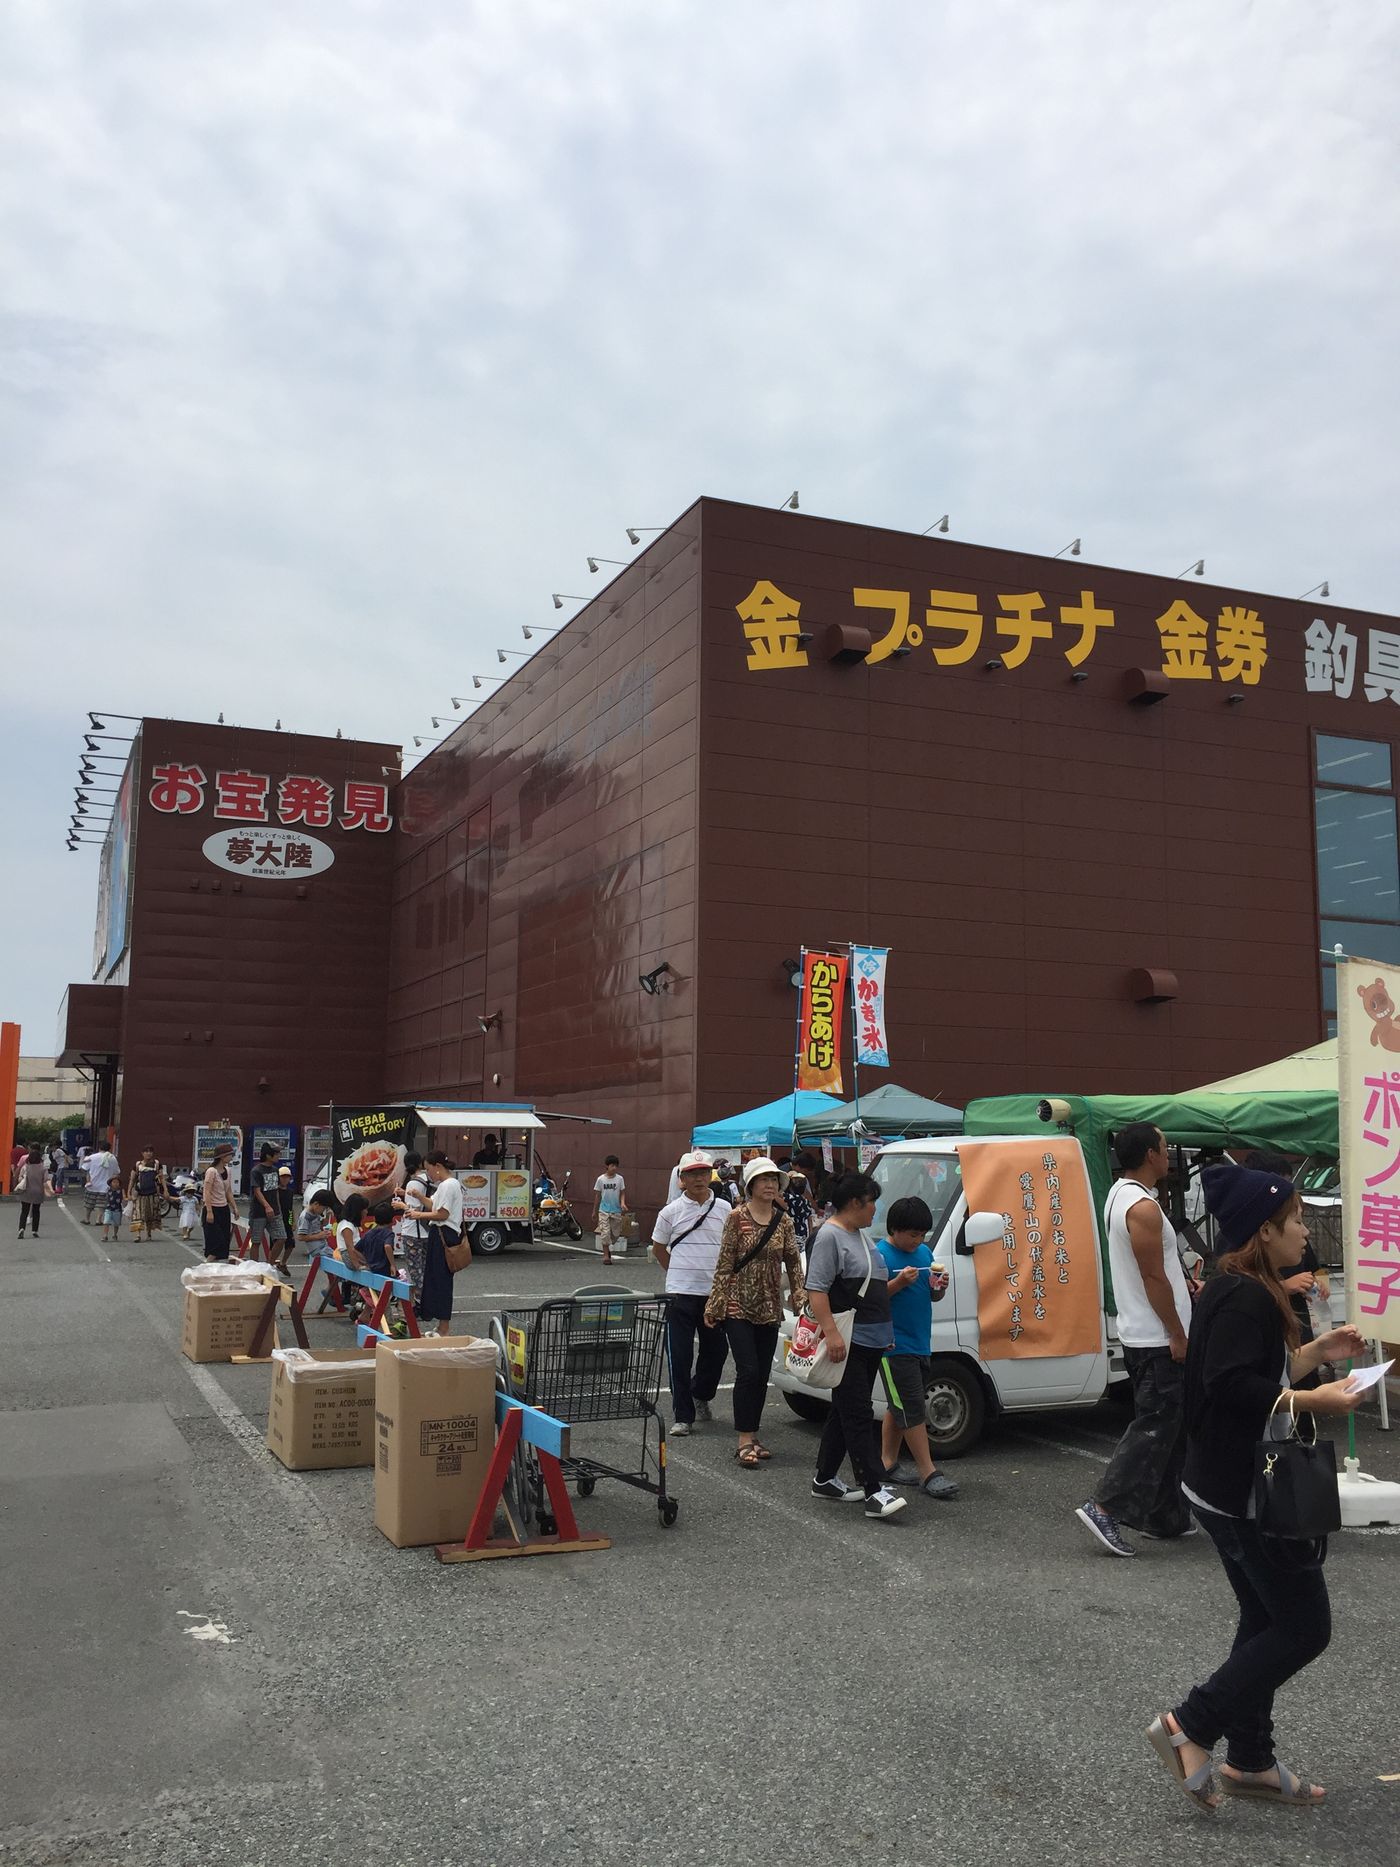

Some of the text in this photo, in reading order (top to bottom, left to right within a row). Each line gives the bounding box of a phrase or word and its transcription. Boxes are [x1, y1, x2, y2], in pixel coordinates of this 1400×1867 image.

[735, 580, 1400, 707] 金 プラチナ 金券 釣具
[149, 762, 393, 833] お宝発見
[225, 837, 313, 869] 夢大陸
[809, 960, 838, 1070] からあげ
[857, 977, 883, 1051] かき氷
[351, 1112, 386, 1128] KEBAB
[362, 1118, 406, 1137] FACTORY
[1042, 1153, 1070, 1284] 県内産のお米と
[1357, 1071, 1400, 1315] ポン菓子
[1000, 1212, 1025, 1342] 使用しています
[1019, 1172, 1046, 1321] 愛鷹山の伏流水を
[429, 1419, 476, 1430] MN-10004
[438, 1443, 455, 1453] 24
